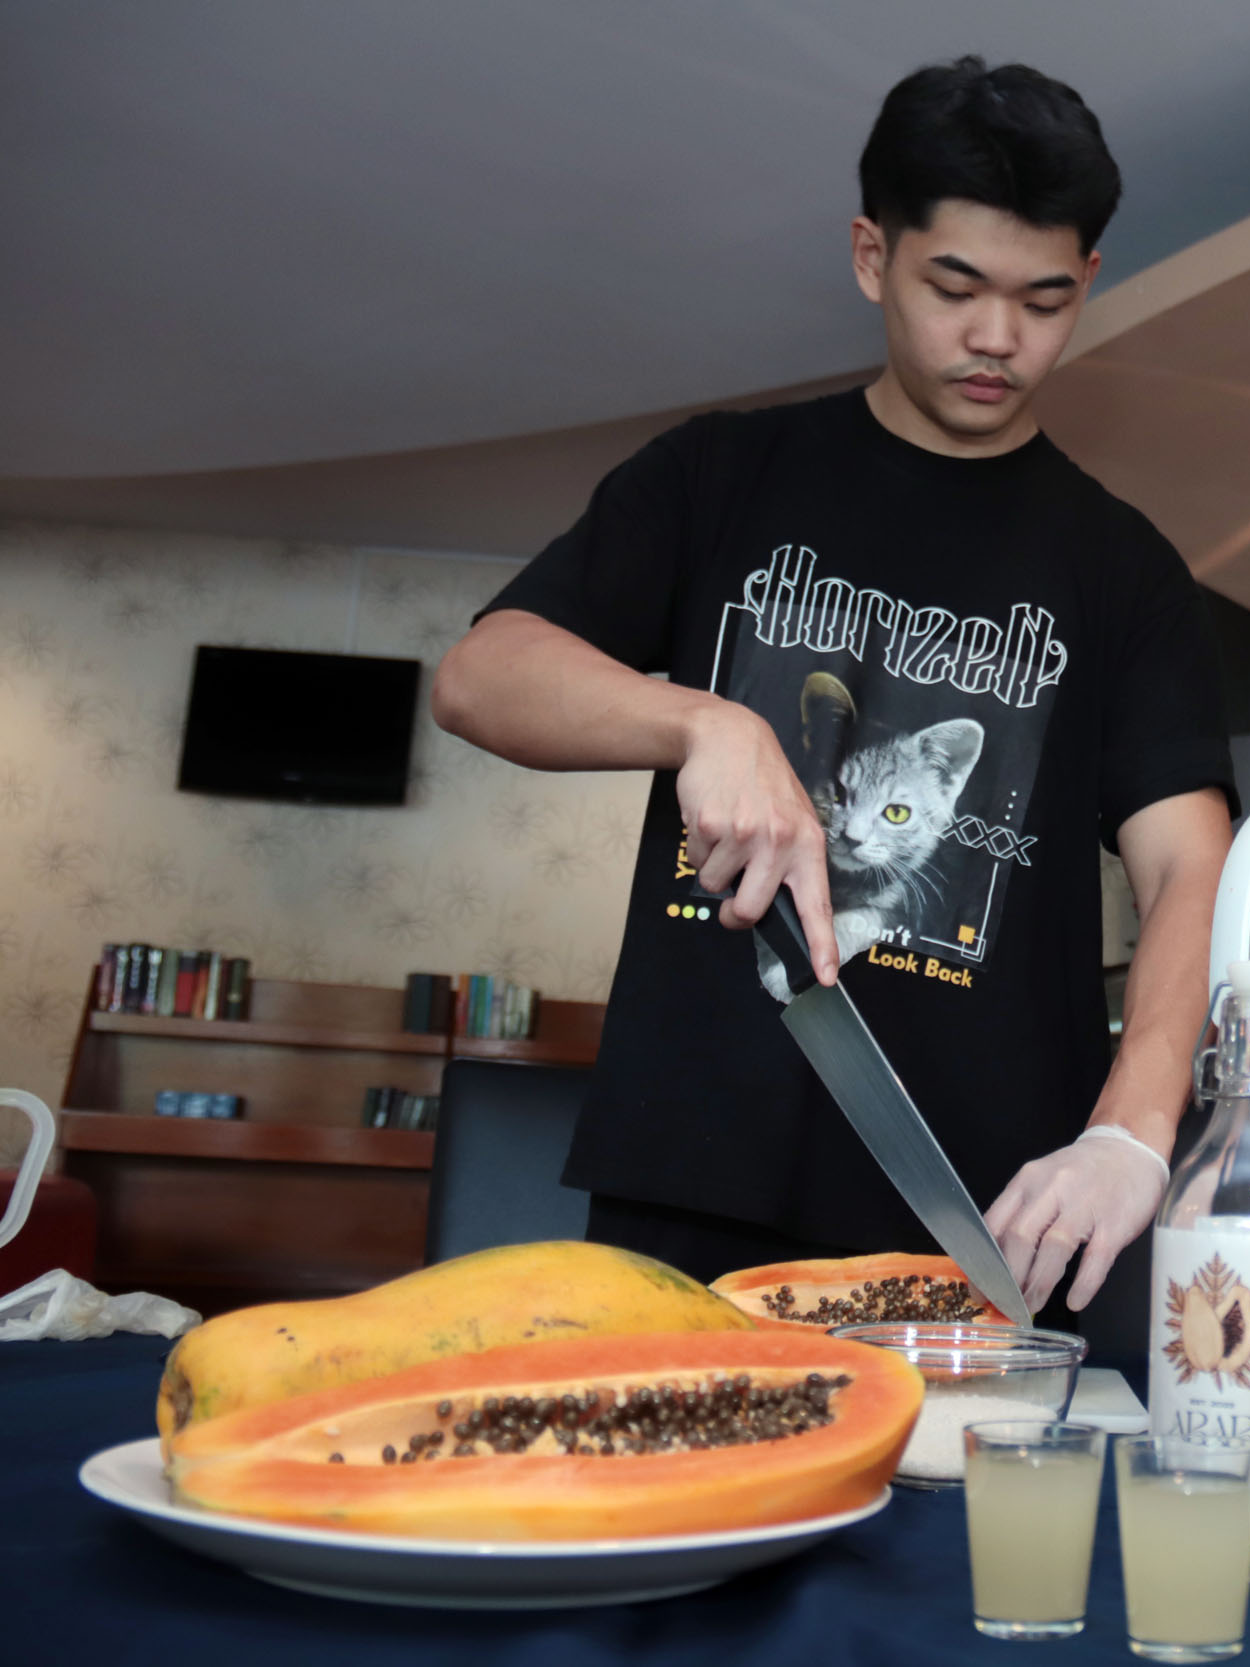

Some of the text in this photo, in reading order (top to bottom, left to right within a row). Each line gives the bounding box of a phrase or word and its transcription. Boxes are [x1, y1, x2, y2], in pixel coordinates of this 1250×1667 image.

[848, 914, 912, 946] Don't
[868, 944, 973, 988] Look Back
